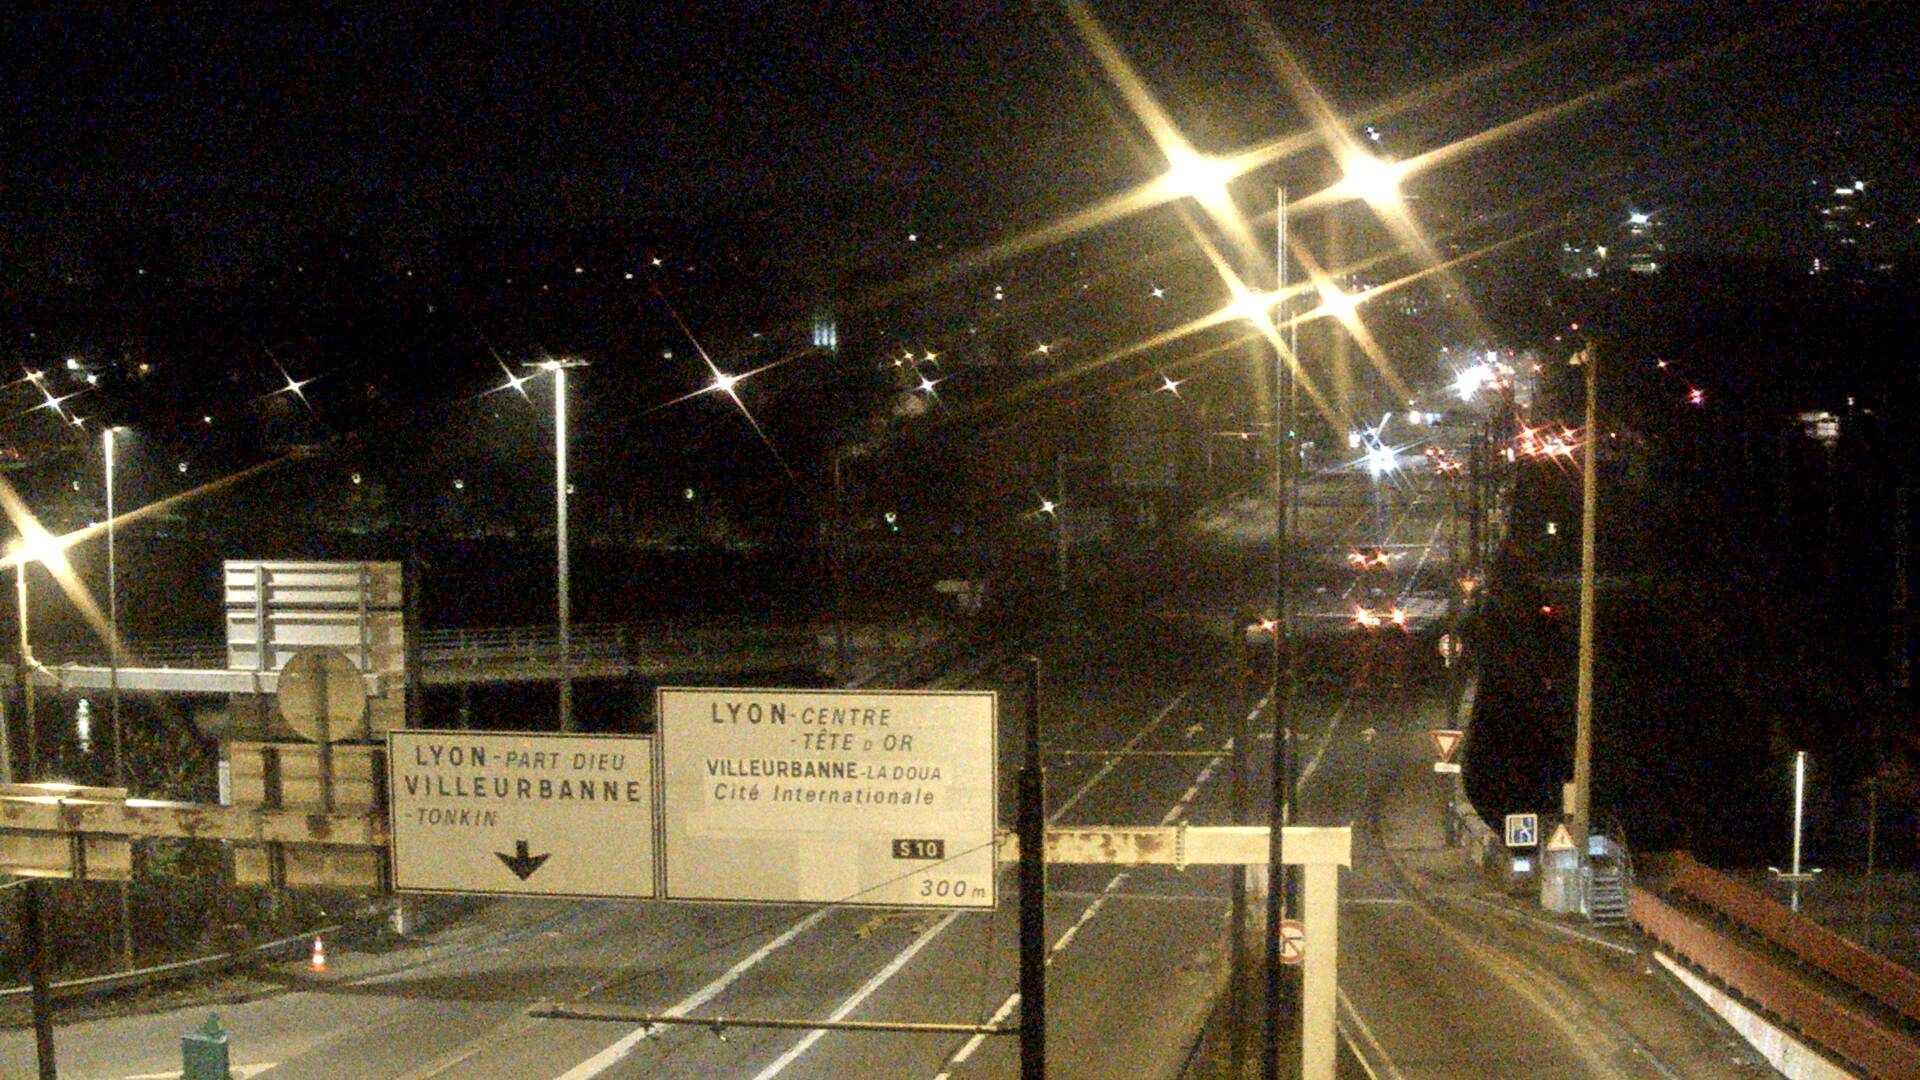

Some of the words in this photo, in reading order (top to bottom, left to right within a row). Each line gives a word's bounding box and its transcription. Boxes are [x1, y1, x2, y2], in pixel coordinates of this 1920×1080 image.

[883, 734, 914, 752] OR
[572, 752, 625, 771] DIEU
[404, 774, 642, 802] VILLEURBANNE
[713, 782, 760, 801] Cité
[773, 784, 935, 806] Internationale
[916, 843, 938, 857] 10
[920, 879, 967, 898] 300
[971, 886, 986, 898] m
